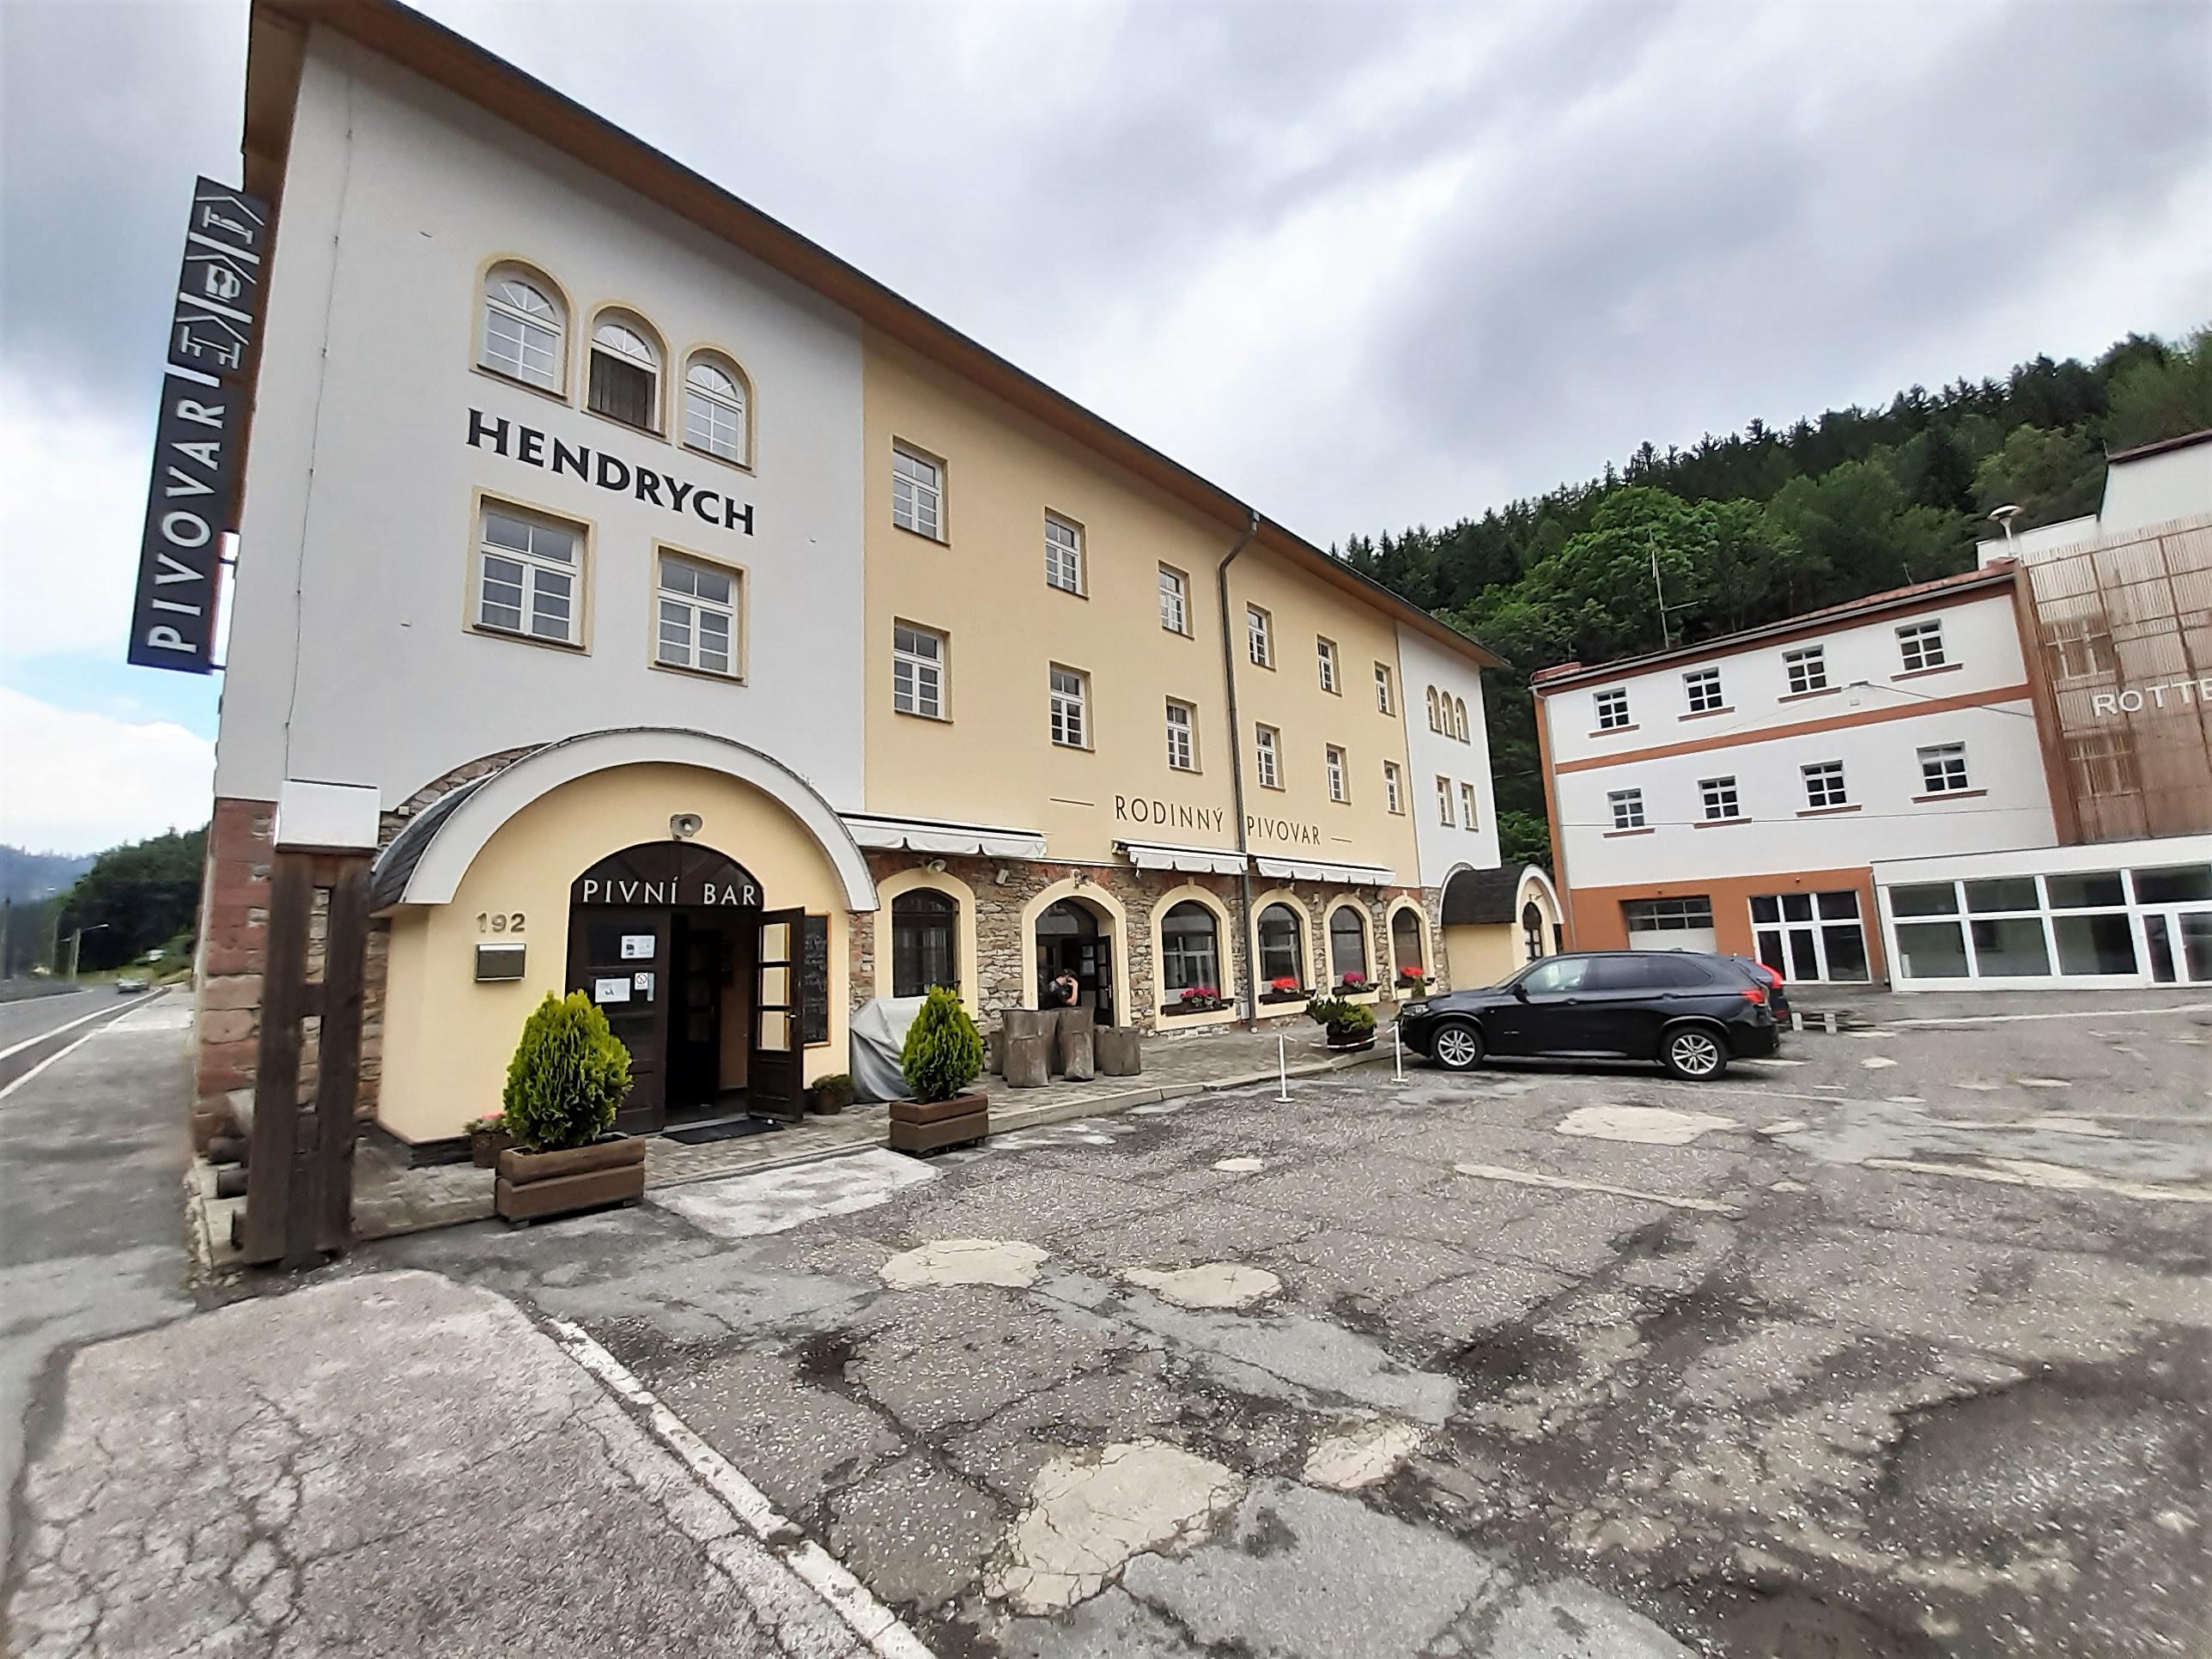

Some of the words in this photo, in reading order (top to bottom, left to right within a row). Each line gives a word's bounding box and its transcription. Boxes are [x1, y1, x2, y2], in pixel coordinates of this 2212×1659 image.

[465, 407, 754, 537] HENDRYCH
[147, 398, 226, 653] PIVOVAR
[1115, 795, 1223, 833] RODINNÝ
[1247, 816, 1321, 846] PIVOVAR
[583, 876, 678, 904] PIVNÍ
[703, 883, 756, 905] BAR
[477, 913, 526, 933] 192
